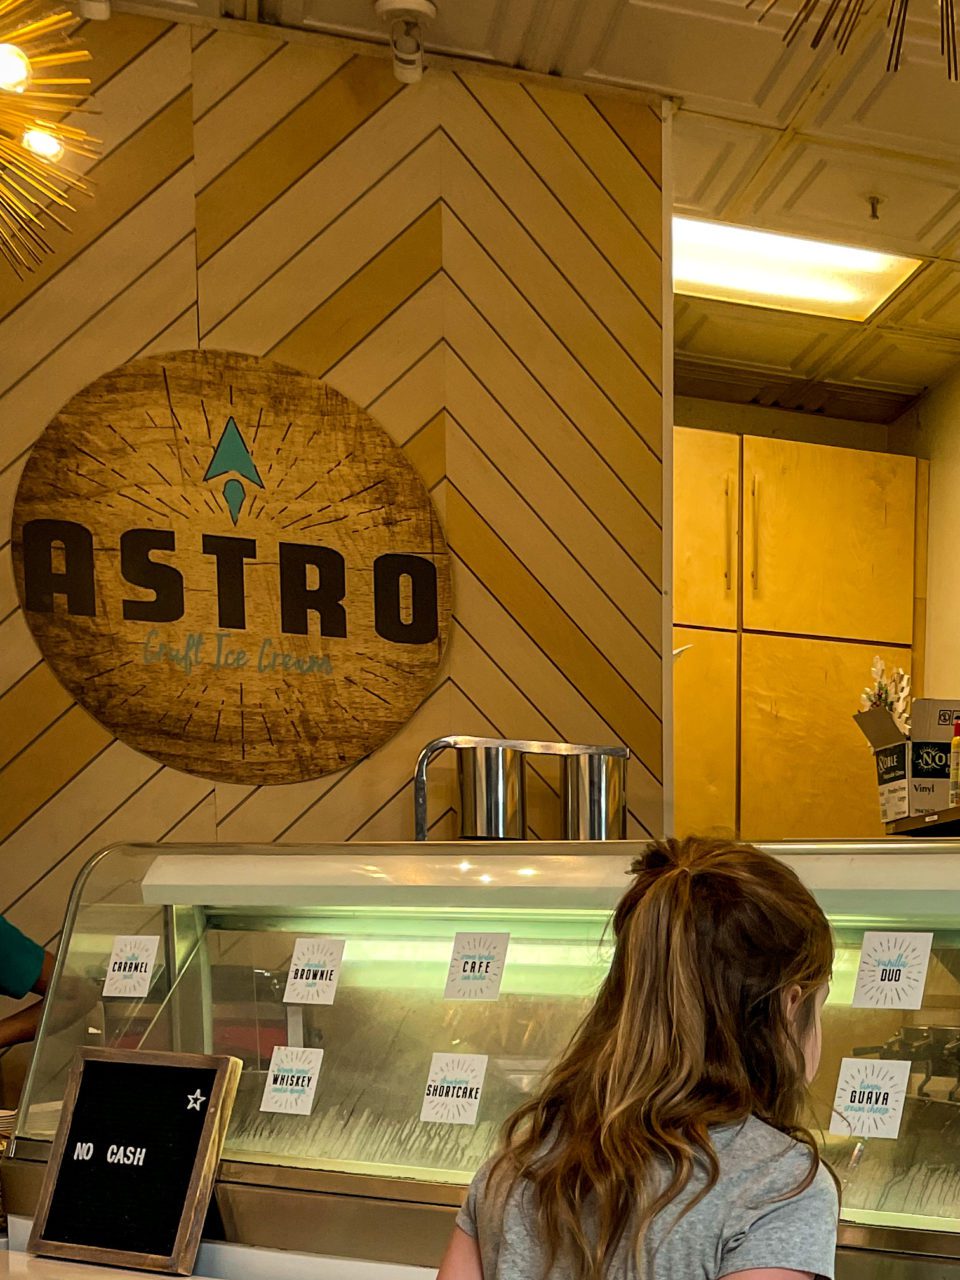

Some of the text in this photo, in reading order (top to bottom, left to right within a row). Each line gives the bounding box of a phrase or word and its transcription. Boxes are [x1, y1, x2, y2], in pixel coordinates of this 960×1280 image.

[22, 518, 439, 645] ASTRO
[143, 629, 334, 676] Craft Ice Cream
[913, 784, 935, 796] Vinyl
[112, 961, 148, 973] CARAMEL
[462, 960, 491, 974] CAFE
[293, 968, 335, 982] BROWNIE
[880, 968, 902, 982] DUO
[272, 1073, 313, 1088] WHISKEY
[426, 1084, 481, 1100] SHORTCAKE
[849, 1090, 890, 1106] GUAVA
[73, 1142, 146, 1166] NO CASH
